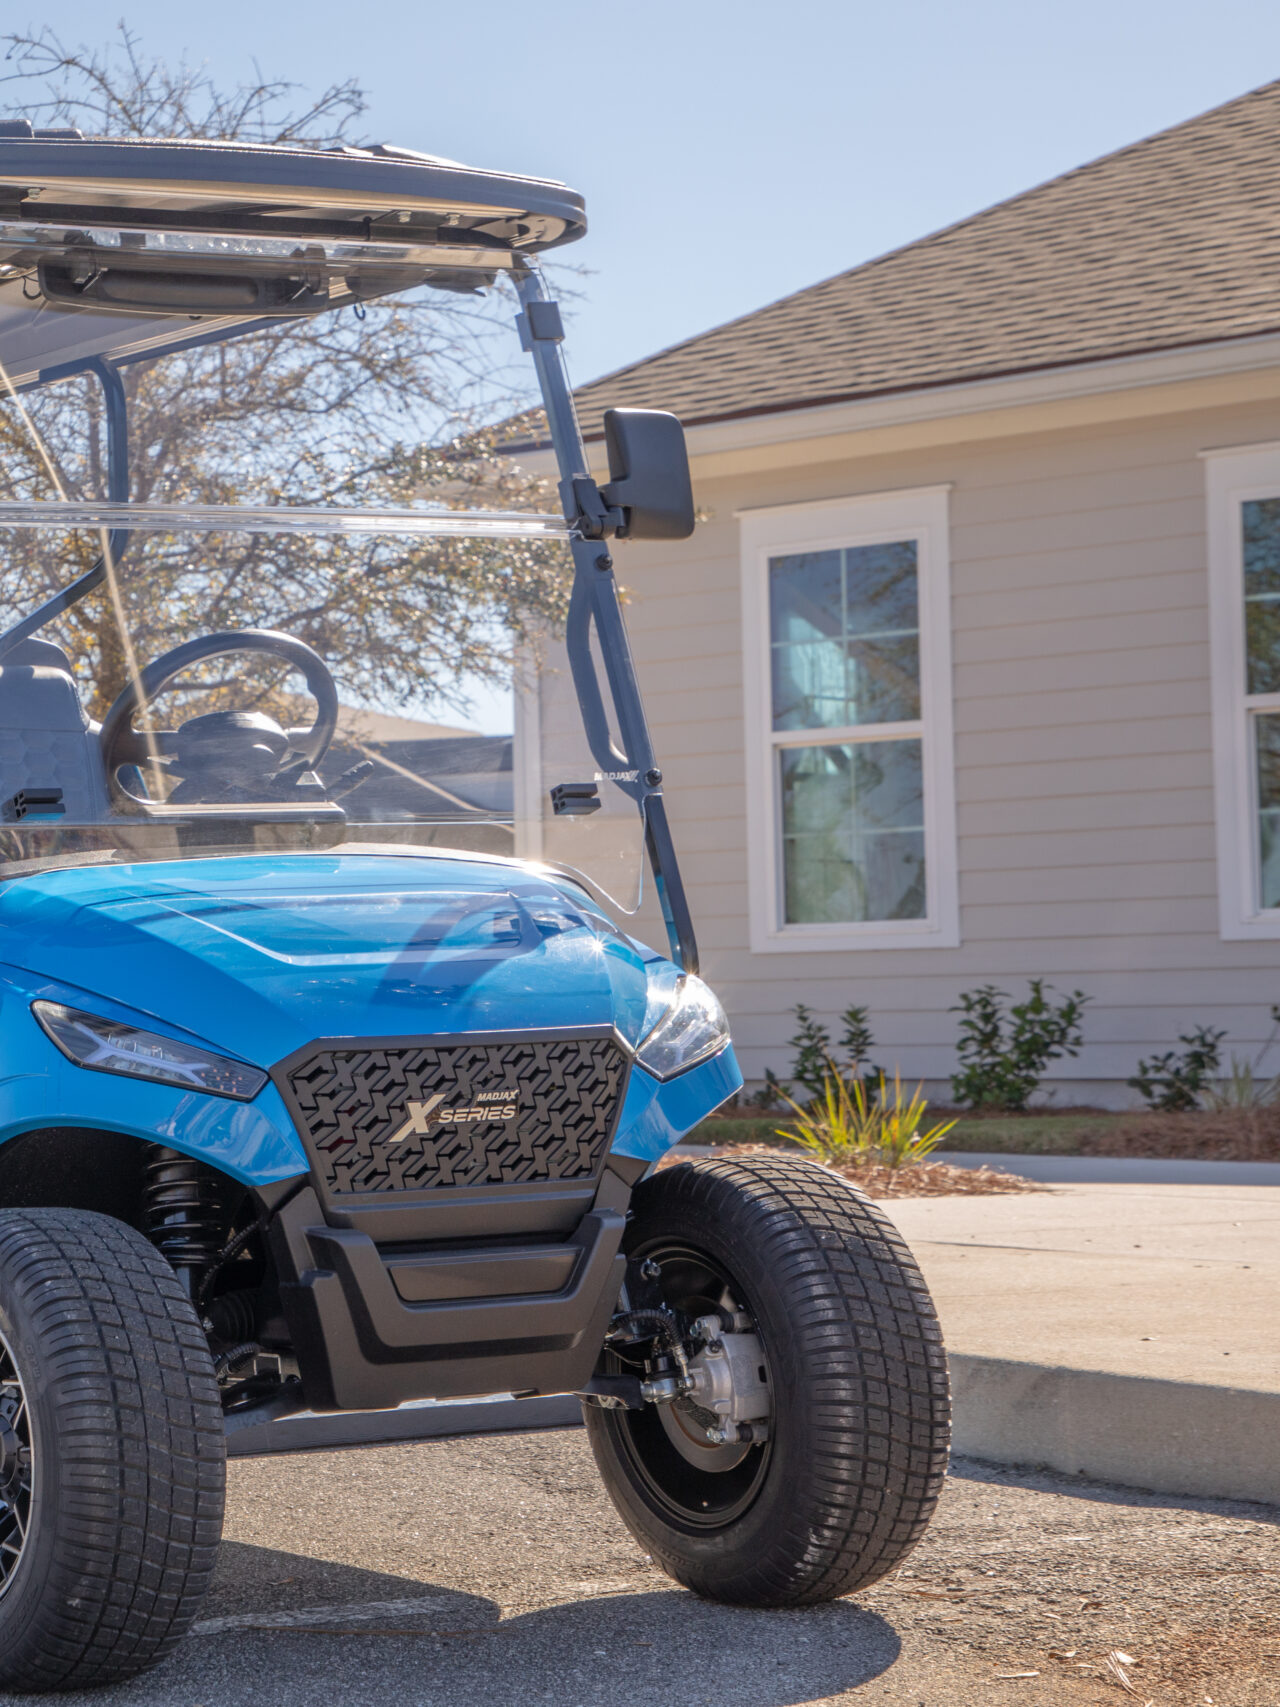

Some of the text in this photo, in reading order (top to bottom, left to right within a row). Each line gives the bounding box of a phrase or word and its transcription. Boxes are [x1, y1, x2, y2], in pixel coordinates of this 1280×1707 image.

[477, 1089, 519, 1102] MADJAX
[389, 1093, 516, 1143] X SERIES
